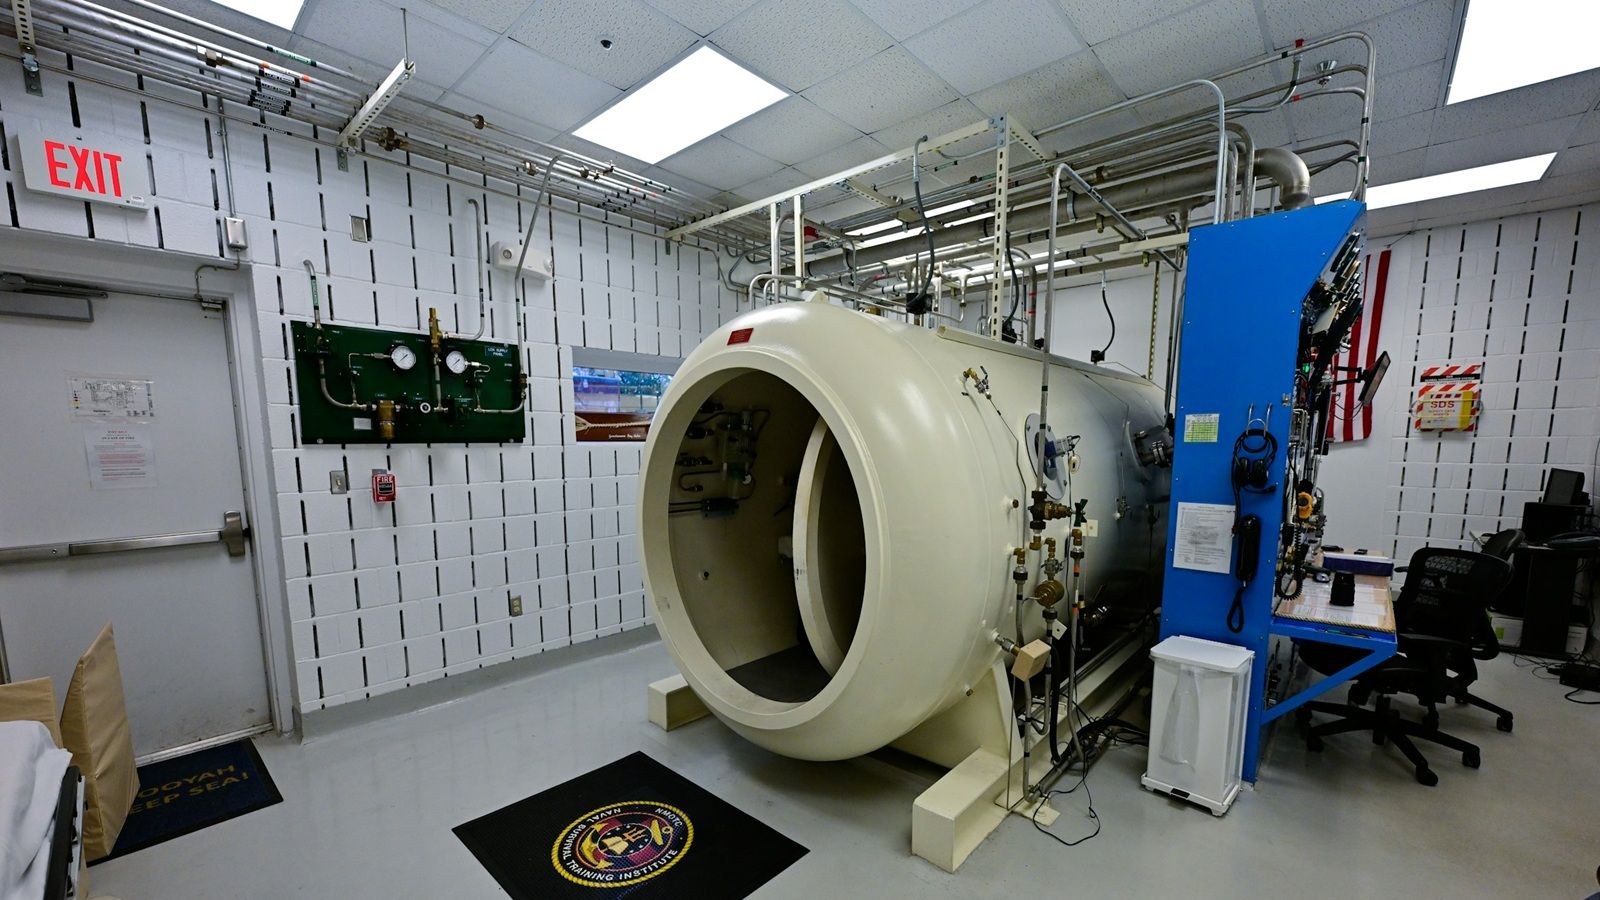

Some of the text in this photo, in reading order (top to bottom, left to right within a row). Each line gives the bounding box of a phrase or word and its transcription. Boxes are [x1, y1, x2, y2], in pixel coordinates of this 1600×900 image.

[44, 139, 122, 198] EXIT
[1430, 400, 1455, 409] SDS
[129, 771, 249, 815] EEP SEA!
[138, 764, 236, 798] OOYAH
[586, 807, 622, 823] NAVAL
[654, 807, 683, 828] NMOTC
[566, 859, 614, 881] TRAINING
[619, 849, 678, 880] INSTITUTE
